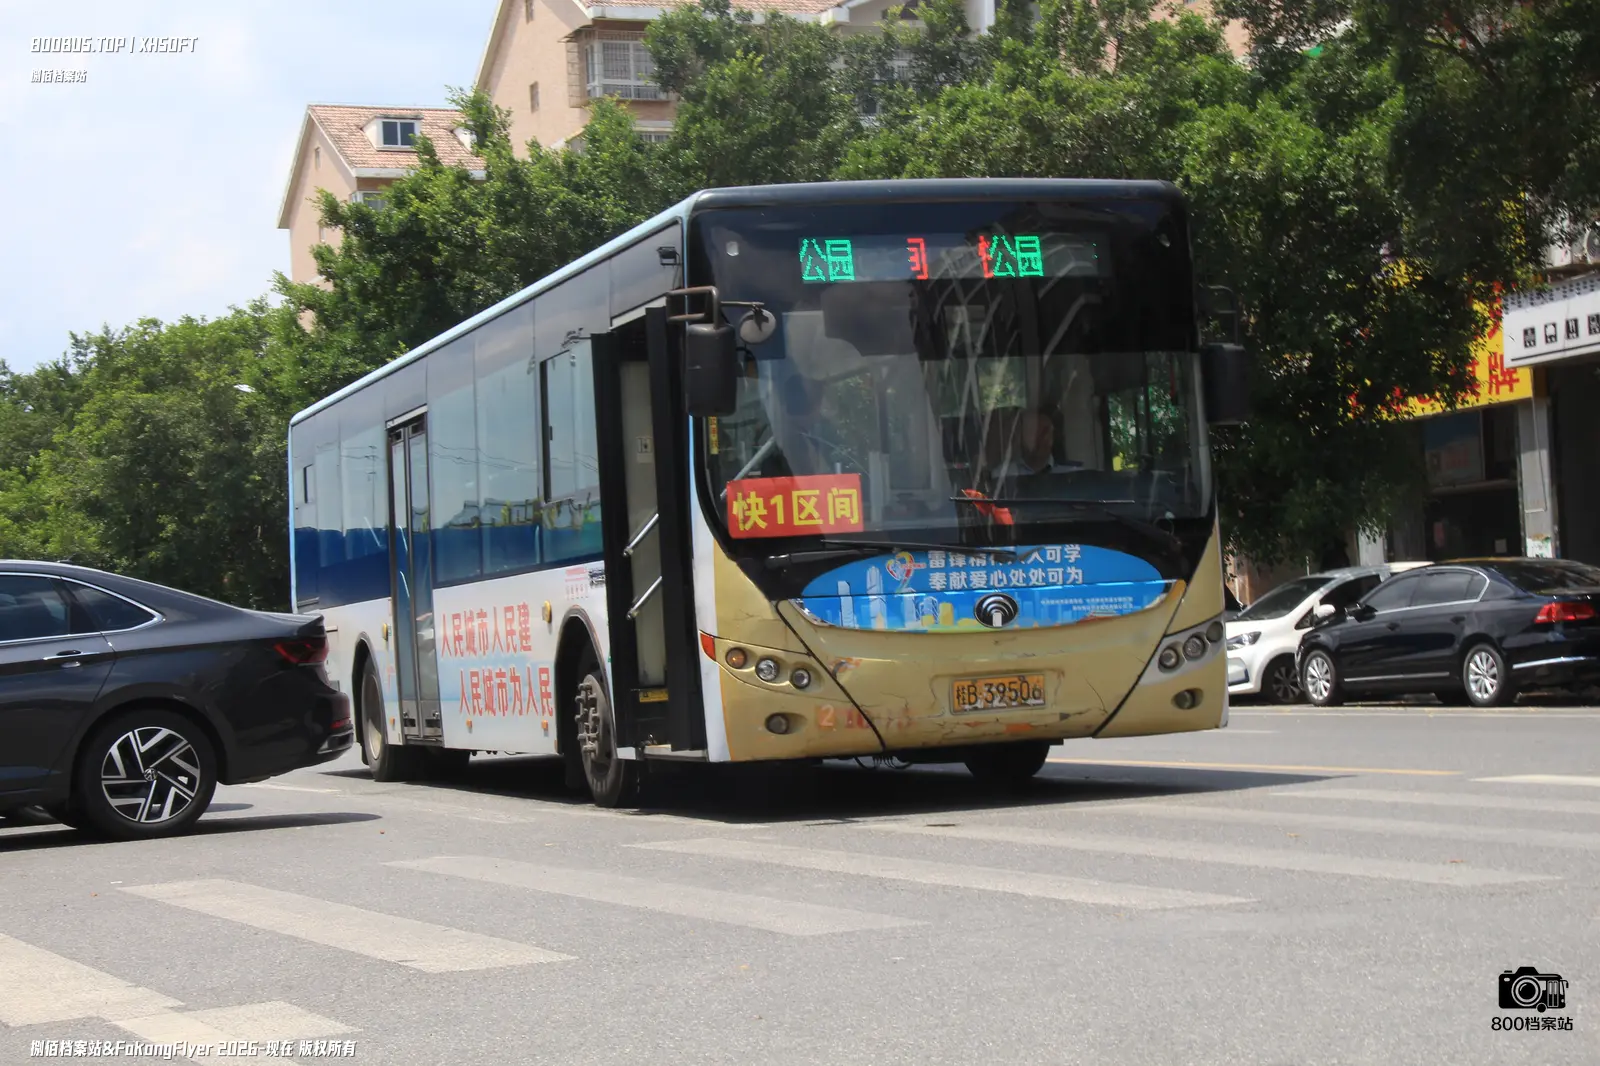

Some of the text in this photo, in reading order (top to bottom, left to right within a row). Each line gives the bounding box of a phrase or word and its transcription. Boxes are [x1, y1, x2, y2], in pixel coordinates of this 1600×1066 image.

[799, 238, 855, 281] 公园
[989, 235, 1044, 277] 公园
[732, 487, 859, 531] 快1区间
[927, 567, 1084, 590] 奉献爱心处处可为
[441, 601, 532, 658] 人民城市人民建
[459, 665, 553, 717] 人民城市为人民
